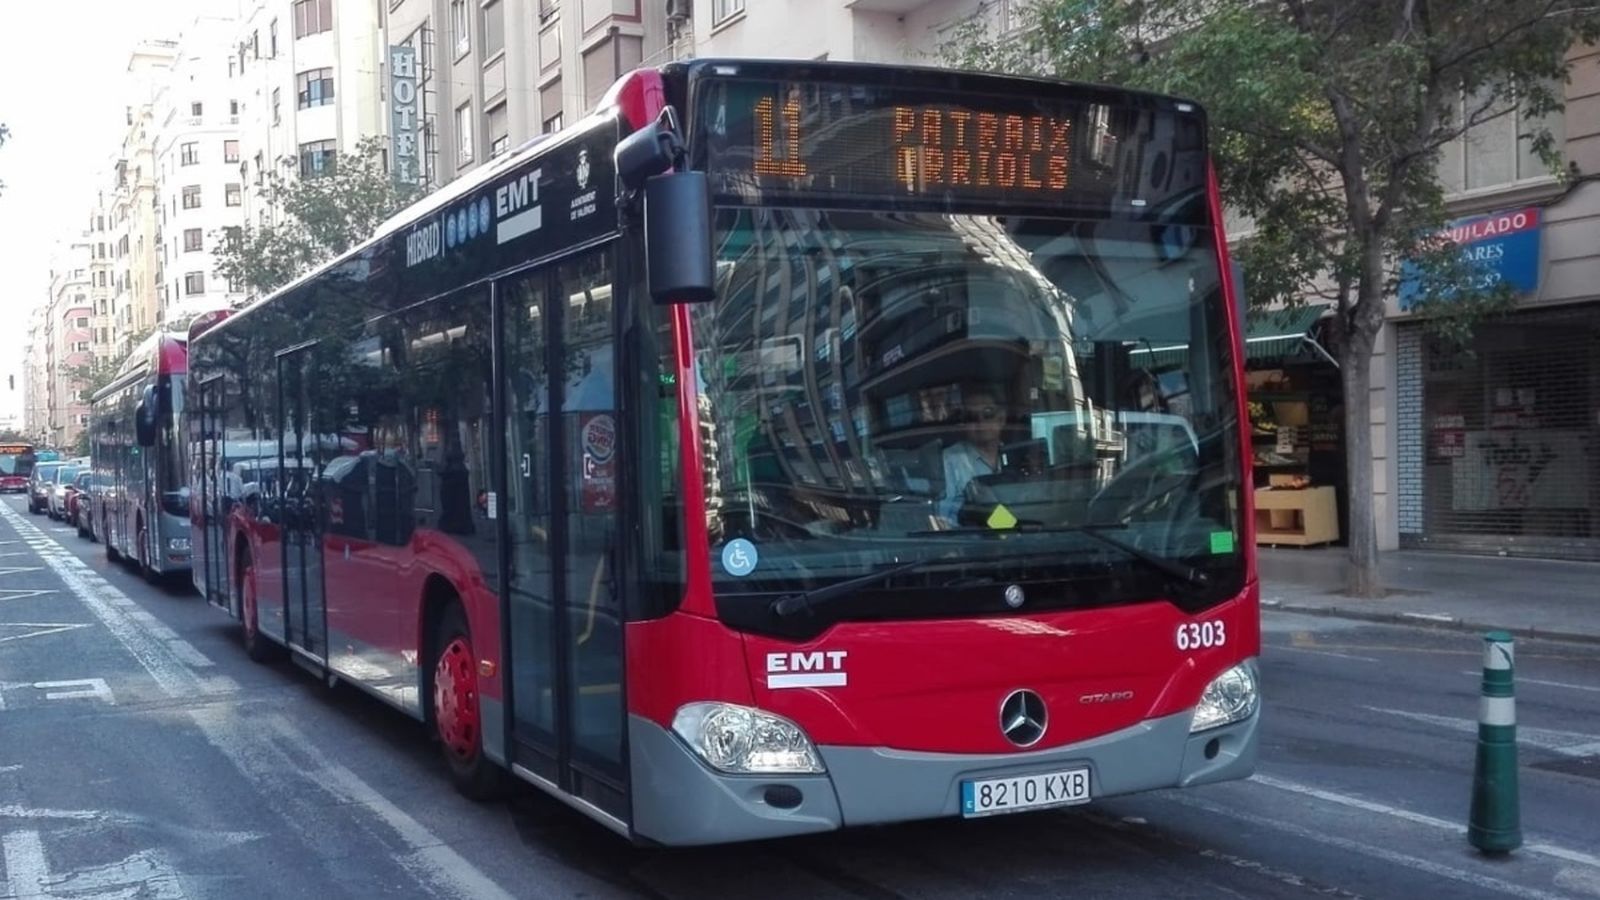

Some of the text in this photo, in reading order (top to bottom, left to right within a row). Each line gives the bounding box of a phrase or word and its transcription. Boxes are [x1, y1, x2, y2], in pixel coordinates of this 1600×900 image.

[392, 53, 417, 184] HOTEL
[754, 97, 806, 175] 11
[895, 107, 1070, 150] PATRAIX
[897, 147, 1068, 188] ORRIOLS
[497, 168, 542, 218] EMT
[406, 222, 440, 268] HÍBRID
[1177, 620, 1226, 650] 6303
[767, 651, 847, 672] EMT
[1079, 691, 1134, 704] CITARO
[980, 779, 1037, 808] 8210
[1045, 773, 1084, 801] KXB
